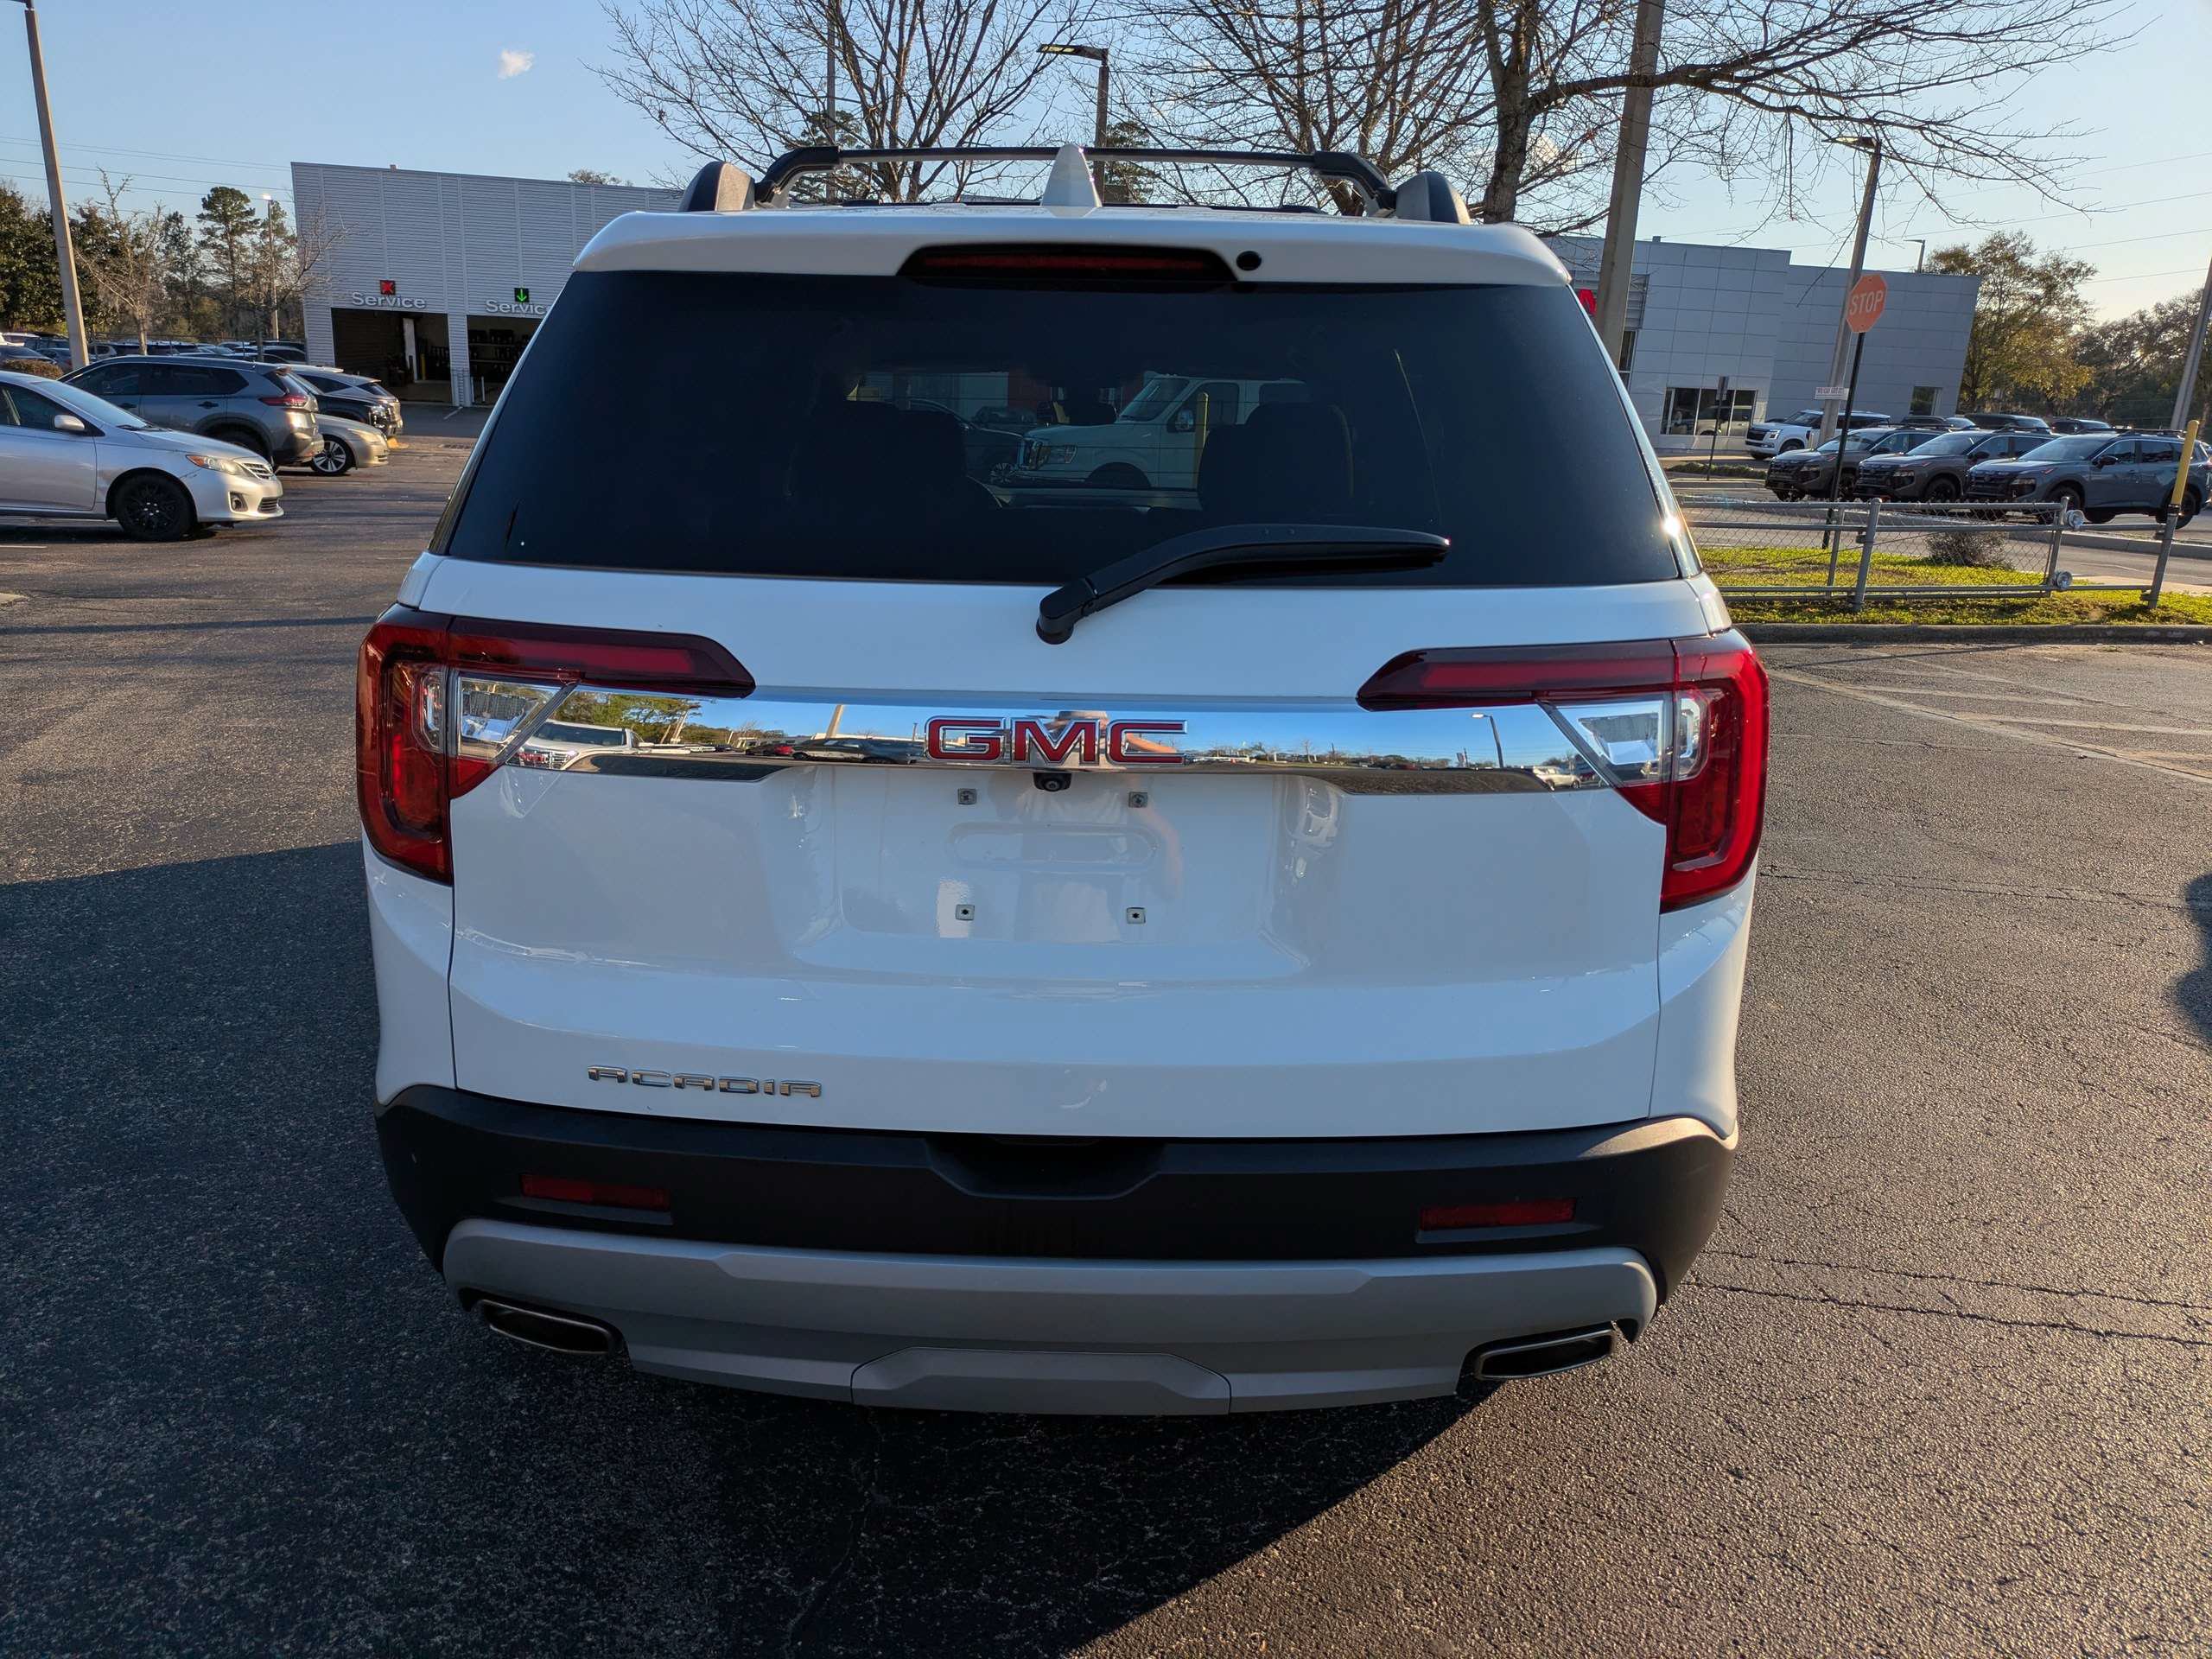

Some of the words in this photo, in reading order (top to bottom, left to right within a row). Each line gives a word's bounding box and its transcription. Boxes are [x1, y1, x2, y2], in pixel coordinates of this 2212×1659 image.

[352, 291, 427, 309] Service
[486, 299, 551, 315] Servic
[1850, 289, 1885, 316] STOP
[924, 715, 1188, 766] GMC
[587, 1064, 823, 1099] ACADIA
